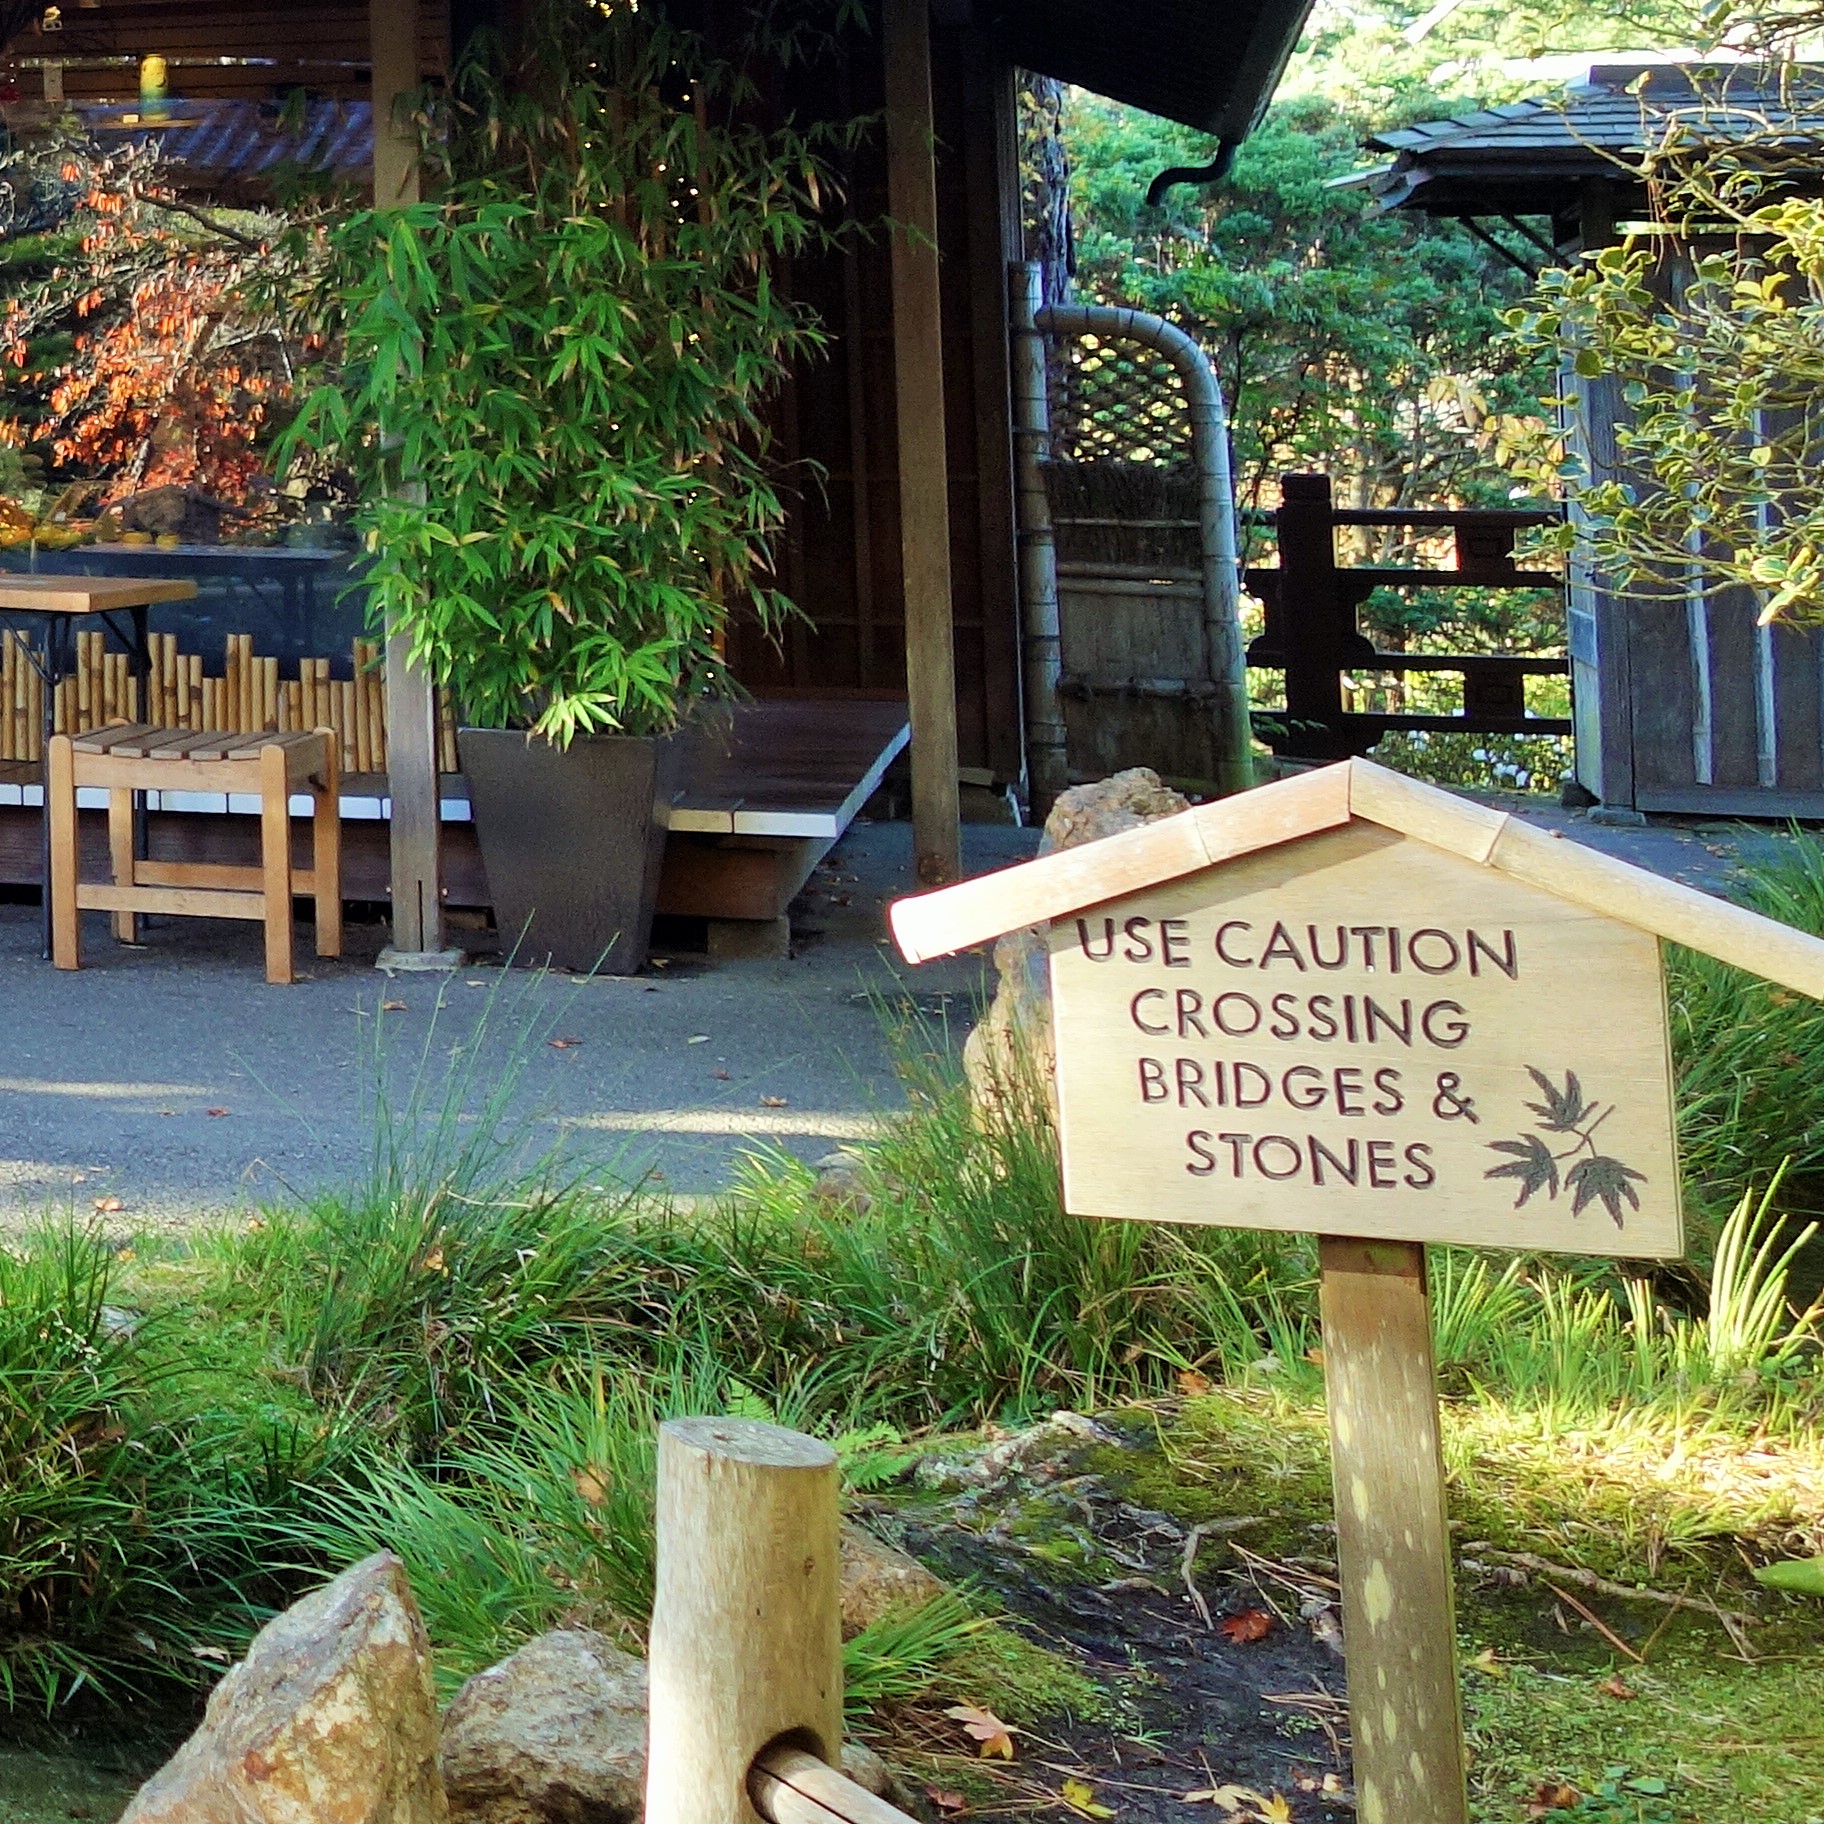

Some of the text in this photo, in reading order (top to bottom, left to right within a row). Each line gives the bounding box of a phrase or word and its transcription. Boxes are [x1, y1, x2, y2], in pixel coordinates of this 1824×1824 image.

[1075, 916, 1519, 981] USE CAUTION
[1129, 987, 1472, 1050] CROSSING
[1137, 1056, 1481, 1125] BRIDGES &
[1185, 1129, 1437, 1190] STONES
